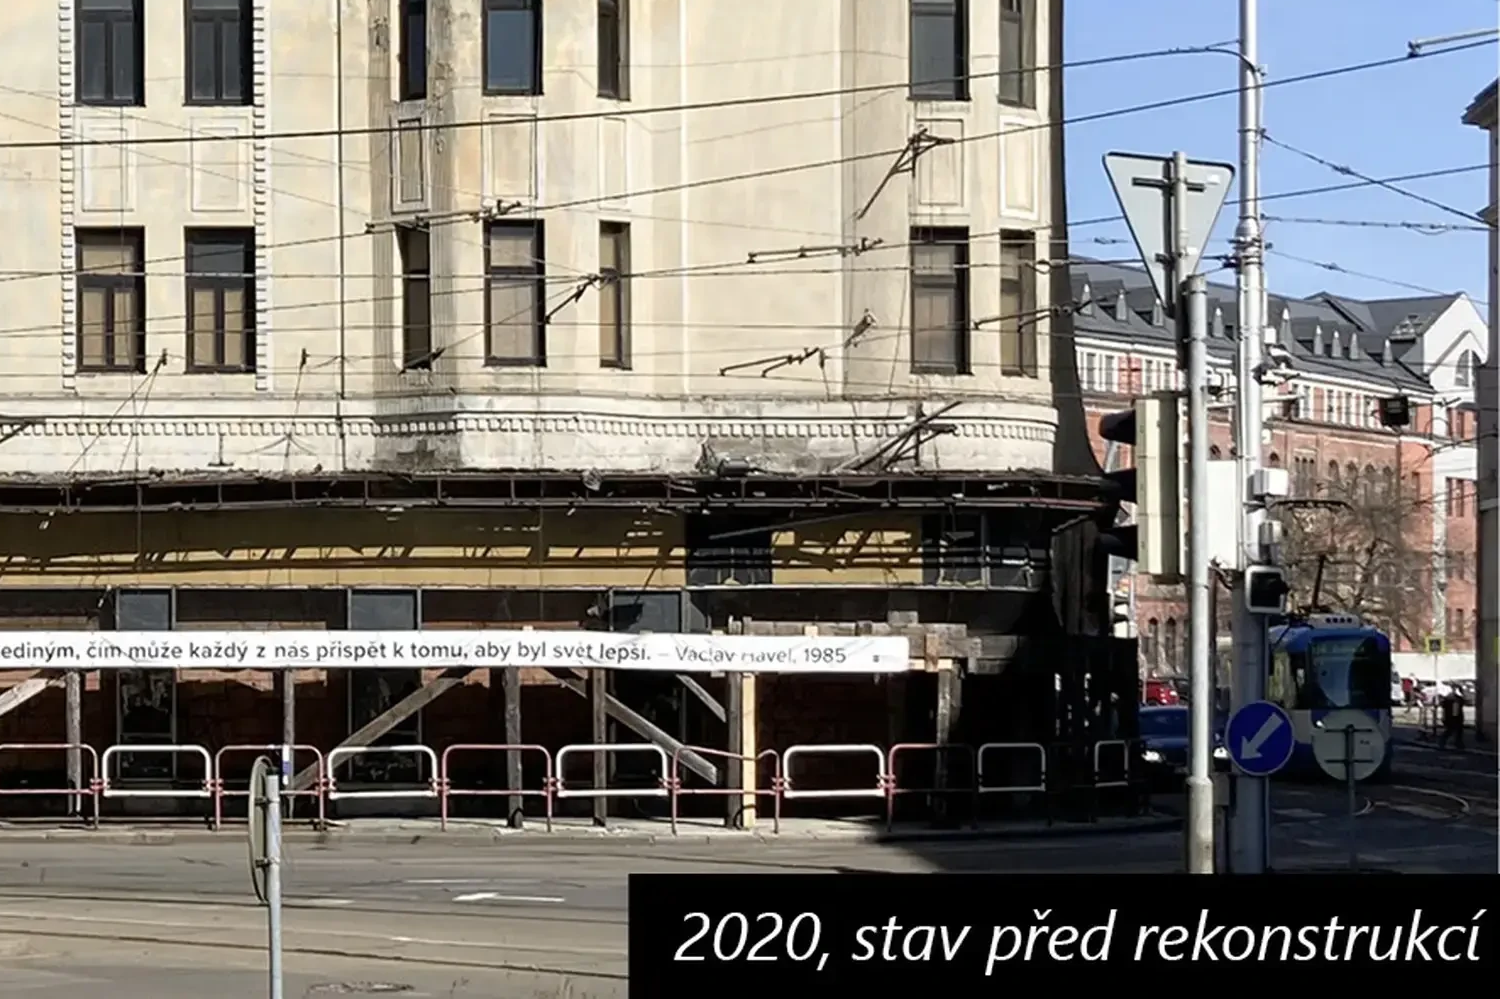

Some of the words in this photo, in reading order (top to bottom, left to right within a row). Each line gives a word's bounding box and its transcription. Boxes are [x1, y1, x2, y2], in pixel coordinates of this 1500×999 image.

[128, 641, 183, 659] může
[189, 641, 249, 663] každý
[256, 645, 266, 659] z
[316, 640, 387, 662] přispět
[393, 641, 404, 659] k
[410, 643, 468, 660] tomu,
[474, 641, 512, 662] aby
[517, 641, 546, 662] byl
[804, 647, 847, 664] 1985
